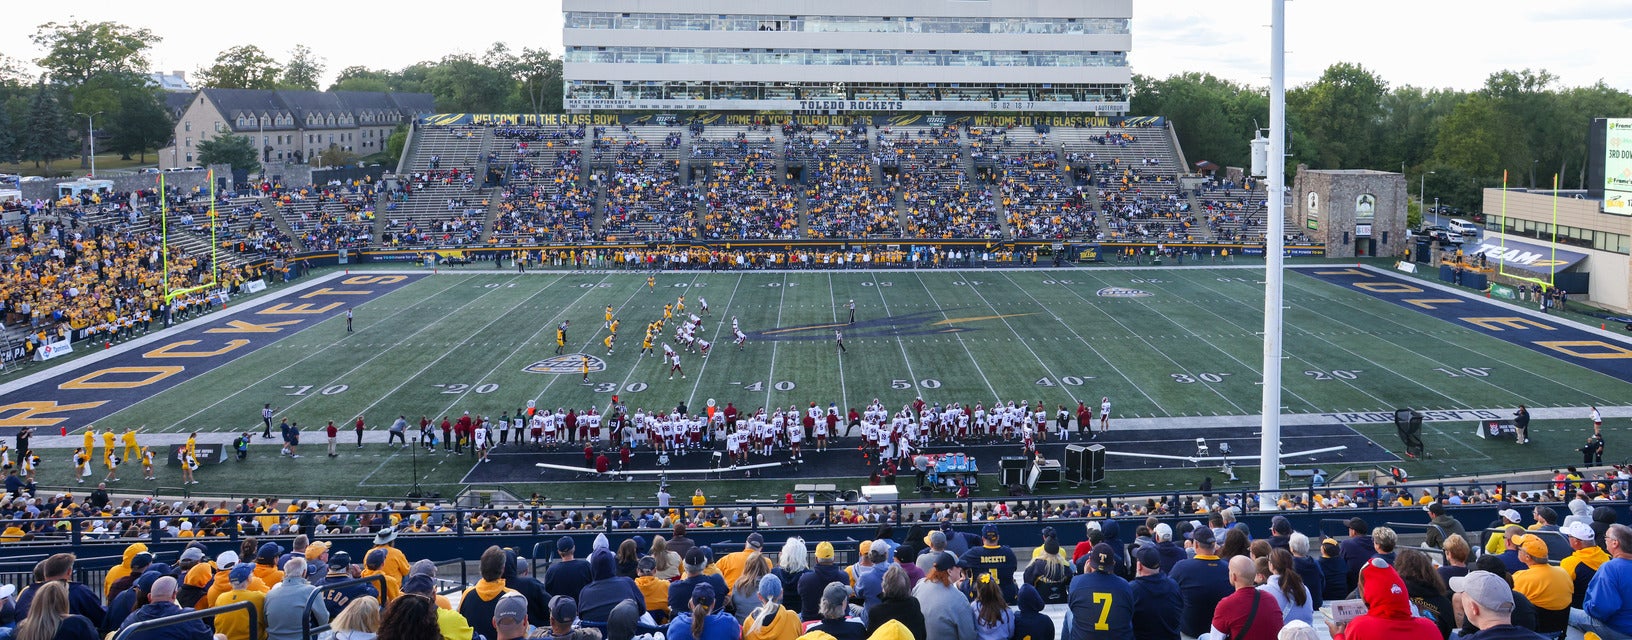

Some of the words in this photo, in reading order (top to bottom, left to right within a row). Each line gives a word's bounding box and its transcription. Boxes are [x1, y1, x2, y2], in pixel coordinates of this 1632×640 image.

[801, 101, 845, 110] TOLEDO
[850, 101, 903, 110] ROCKETS
[524, 114, 536, 125] TO
[540, 114, 558, 125] THE
[560, 114, 592, 125] GLASS
[594, 114, 620, 125] BOWL
[726, 115, 750, 124] HOME
[754, 115, 765, 124] OF
[1021, 116, 1031, 126] TO
[1609, 150, 1620, 158] 3RD
[1474, 244, 1543, 265] TEAM
[0, 275, 408, 427] ROCKETS
[1304, 369, 1358, 380] 20
[1434, 366, 1491, 378] 10
[1035, 376, 1084, 386] 40
[1170, 372, 1223, 384] 30
[440, 383, 499, 394] 20
[594, 382, 648, 393] 30
[744, 381, 796, 392] 40
[891, 379, 942, 389] 50
[286, 384, 349, 396] 10
[1099, 553, 1107, 563] T
[989, 568, 1000, 584] 1
[1092, 592, 1113, 631] 7
